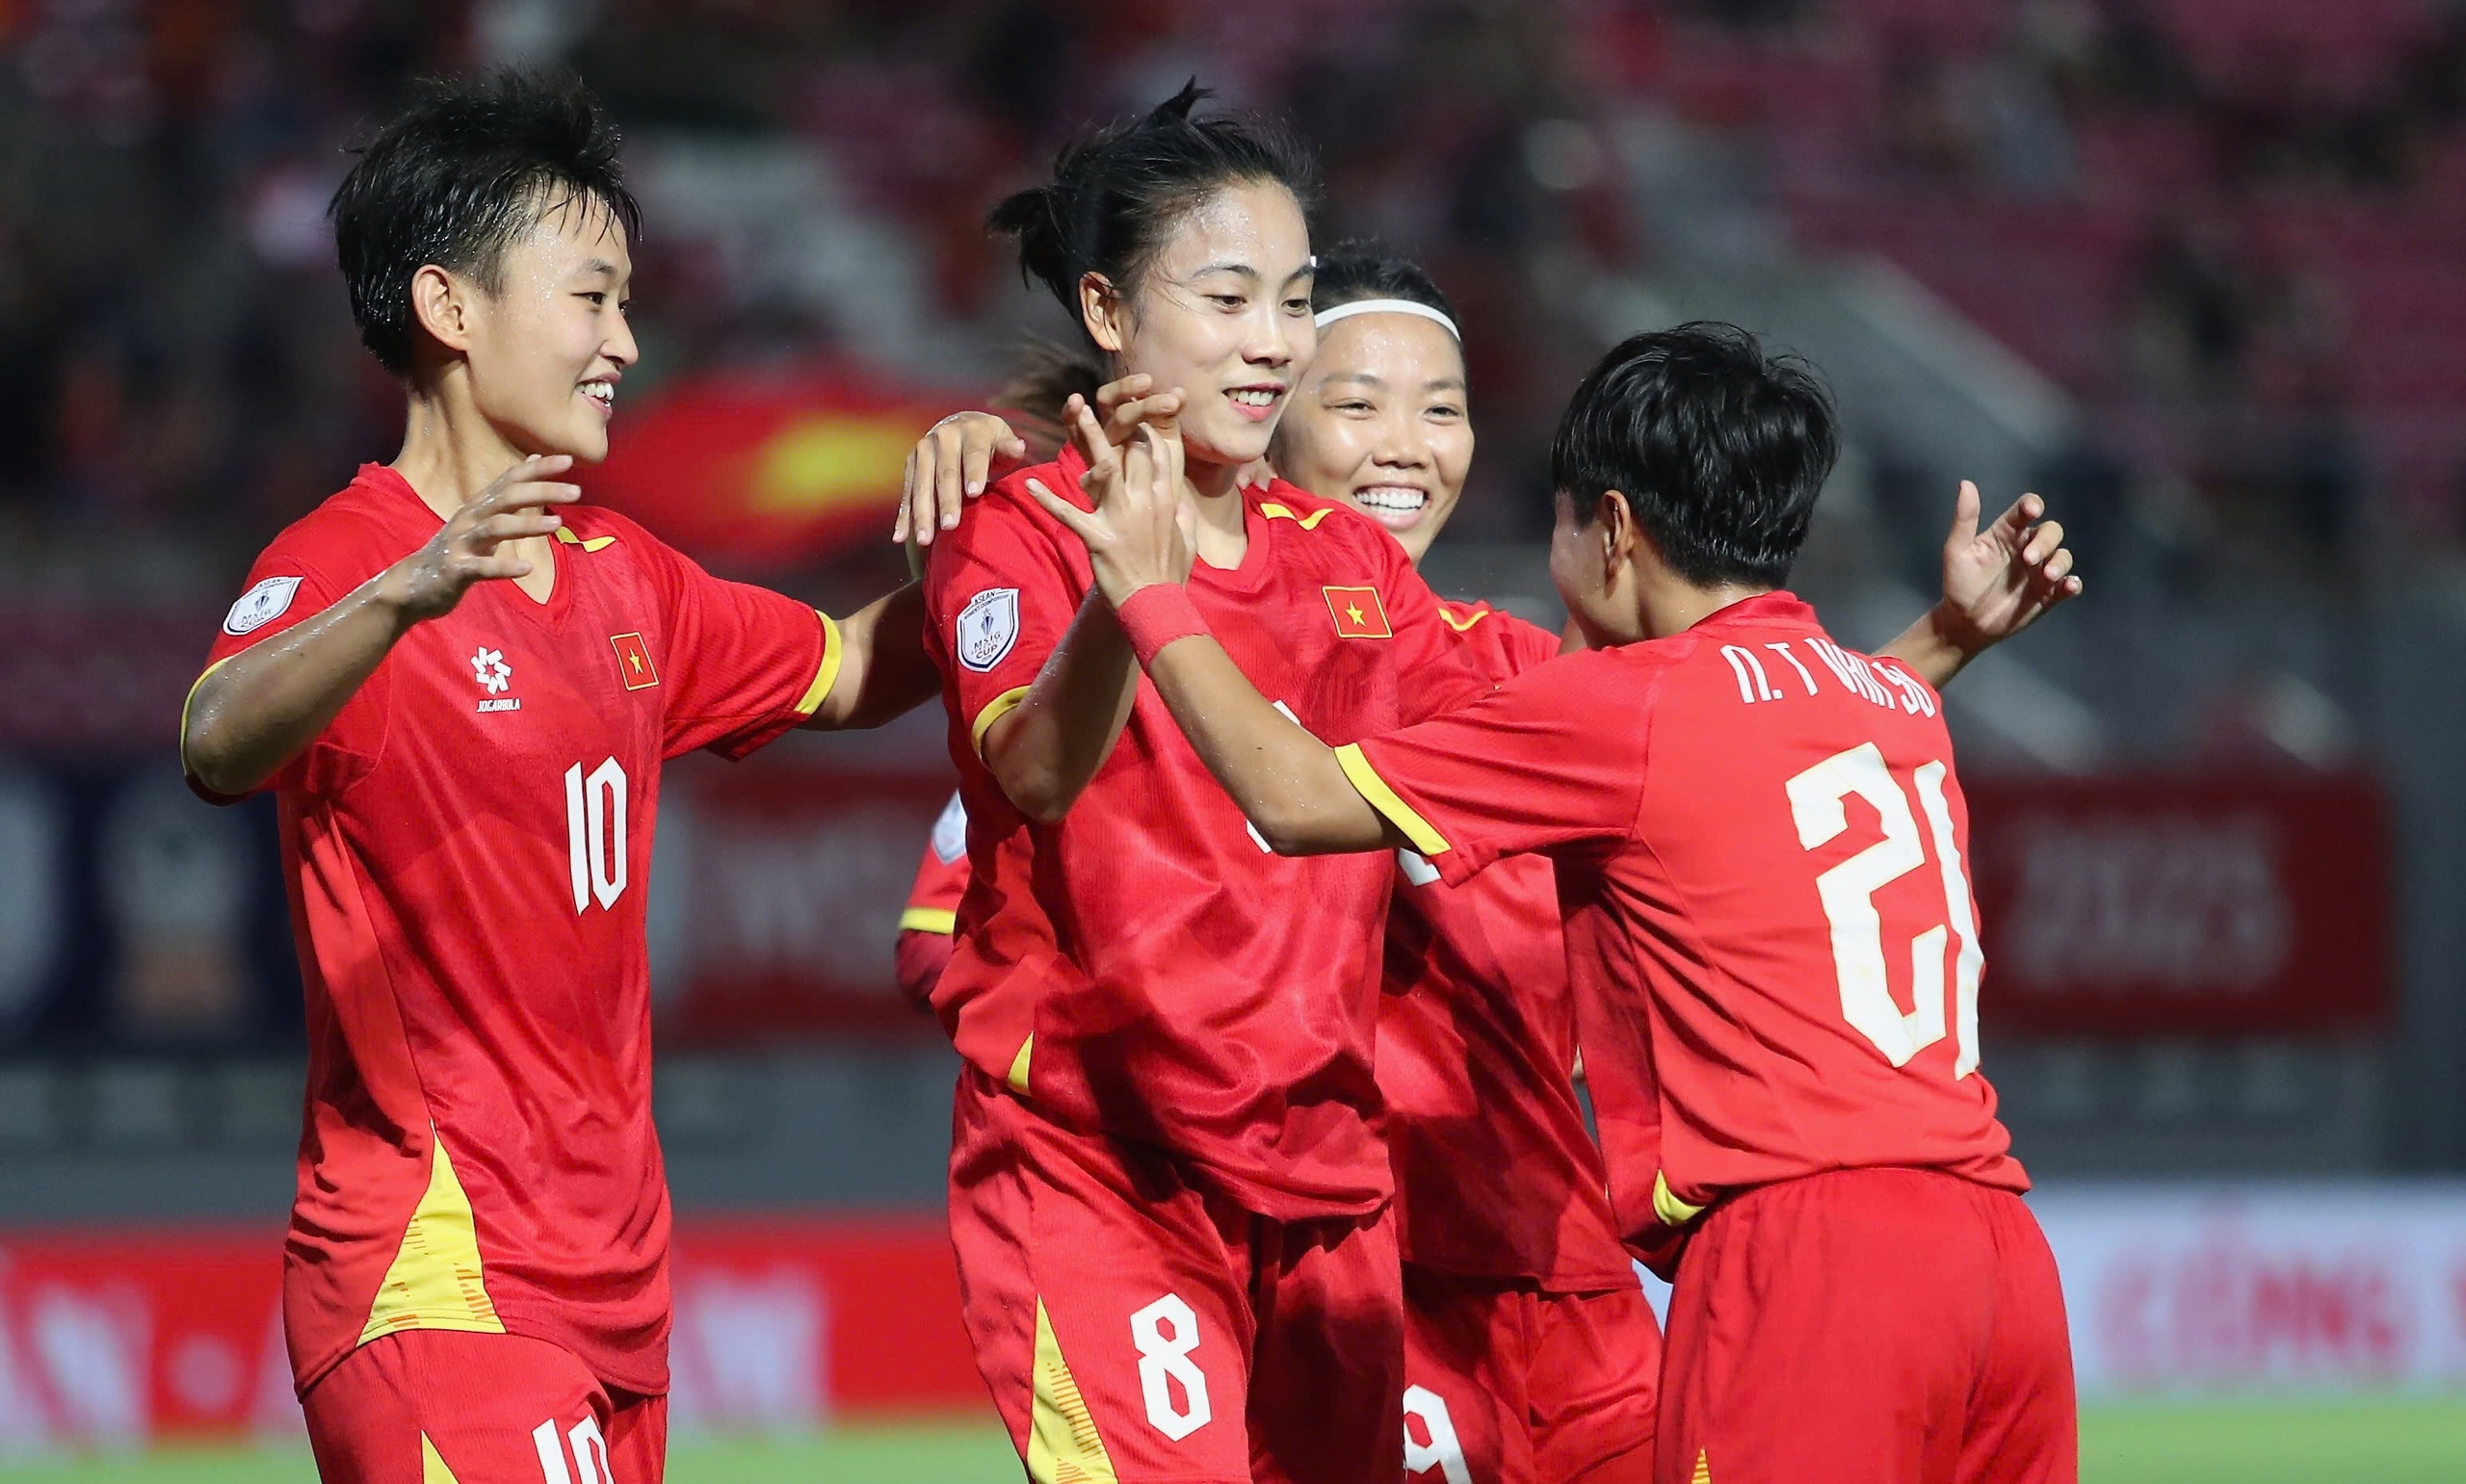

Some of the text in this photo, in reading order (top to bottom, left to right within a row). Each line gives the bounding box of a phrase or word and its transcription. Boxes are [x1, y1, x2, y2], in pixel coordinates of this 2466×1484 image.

[974, 590, 996, 606] ASEAN
[974, 631, 1001, 650] MSIG
[976, 644, 998, 659] CUP
[1764, 641, 1819, 696] T
[476, 697, 521, 713] JOGARBOLA
[564, 755, 628, 916] 10
[1784, 741, 1985, 1081] 21
[1129, 1292, 1213, 1443] 8
